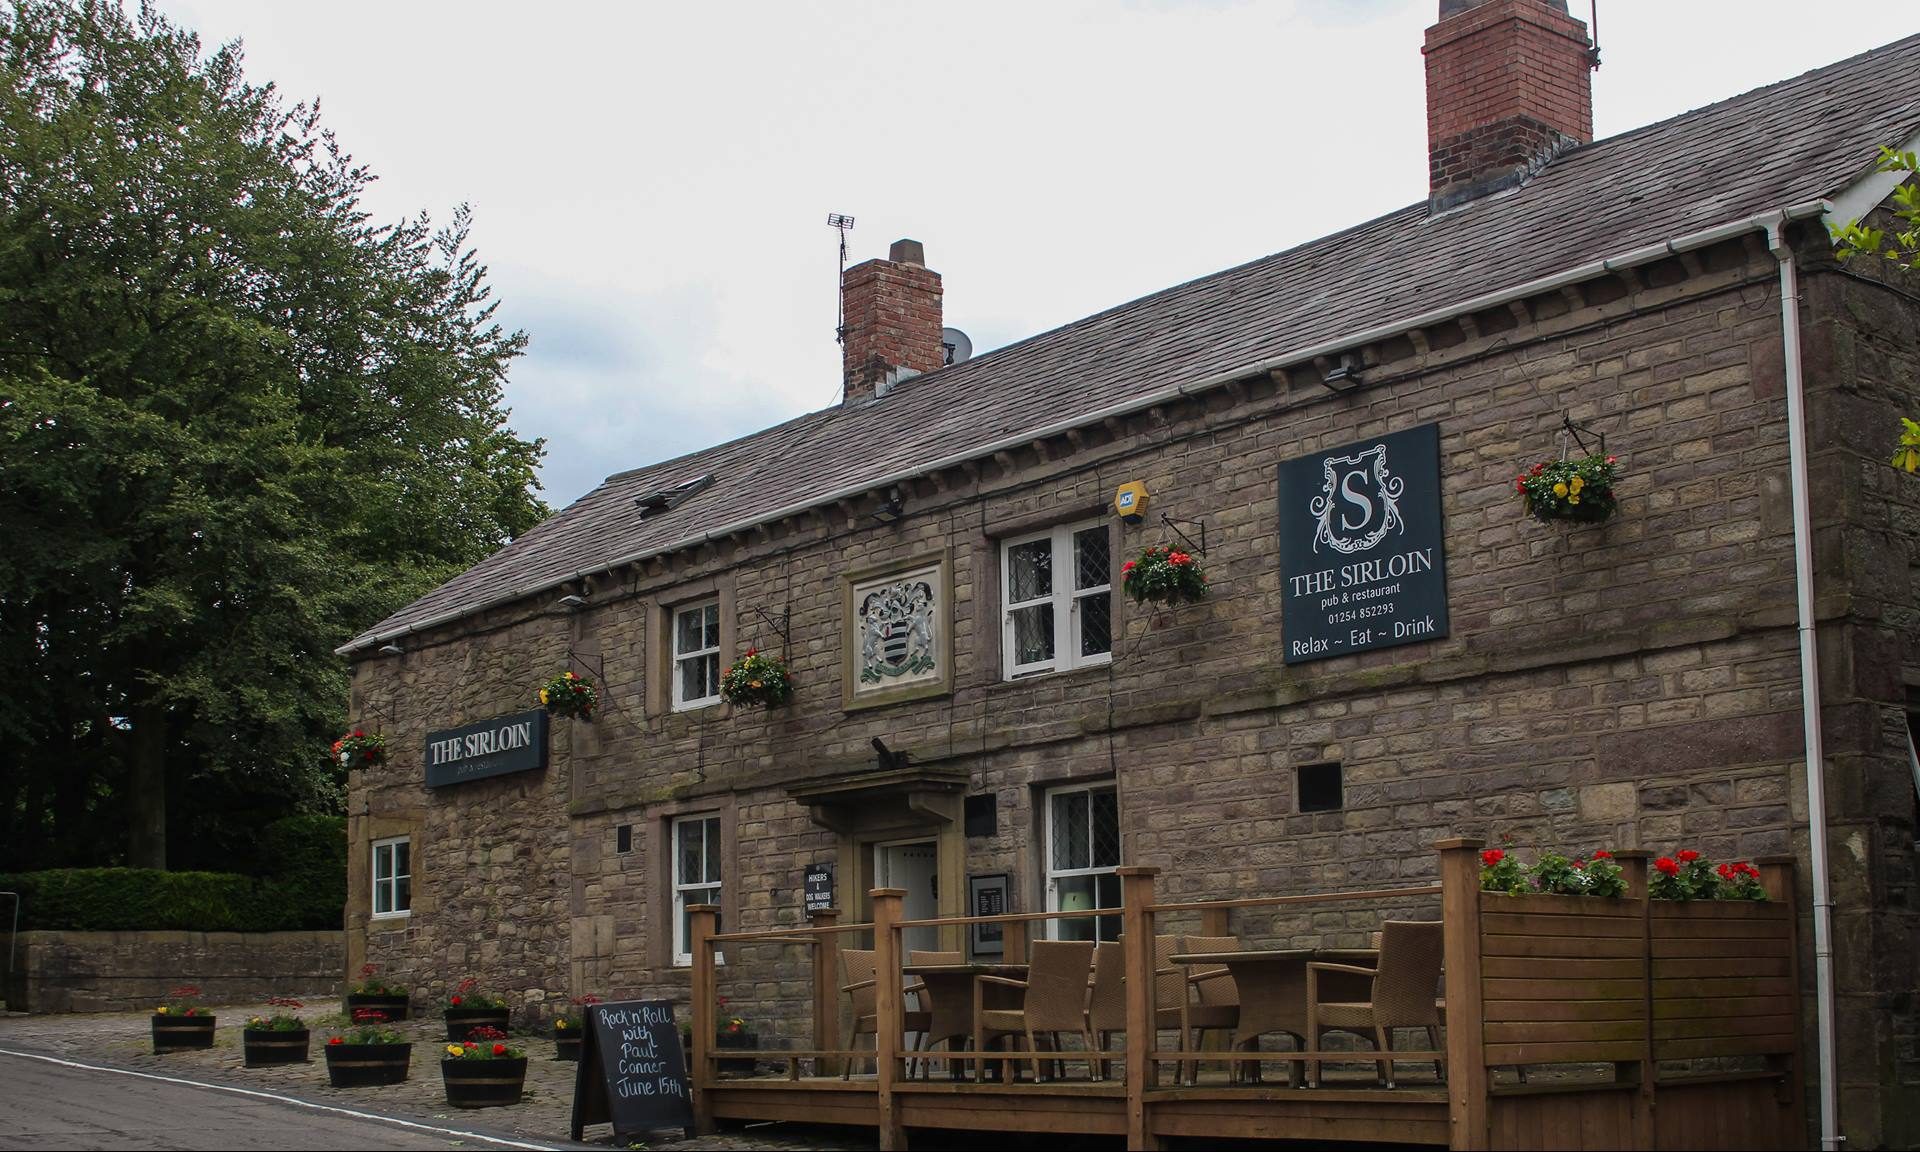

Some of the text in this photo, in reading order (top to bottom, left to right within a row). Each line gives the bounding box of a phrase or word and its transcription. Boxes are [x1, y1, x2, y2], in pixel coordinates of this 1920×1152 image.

[1341, 469, 1373, 531] S
[1289, 548, 1433, 598] THE SIRLOIN
[1321, 582, 1401, 611] pub & restaurant
[1328, 602, 1395, 625] 01254 852293
[1292, 636, 1329, 656] Relax
[1350, 627, 1372, 646] Eat
[1394, 616, 1435, 639] Drink
[430, 721, 532, 765] THE SIRLOIN
[622, 1025, 658, 1048] with
[621, 1042, 658, 1059] Paul
[618, 1058, 667, 1075] Conner
[616, 1077, 684, 1098] June 15th
